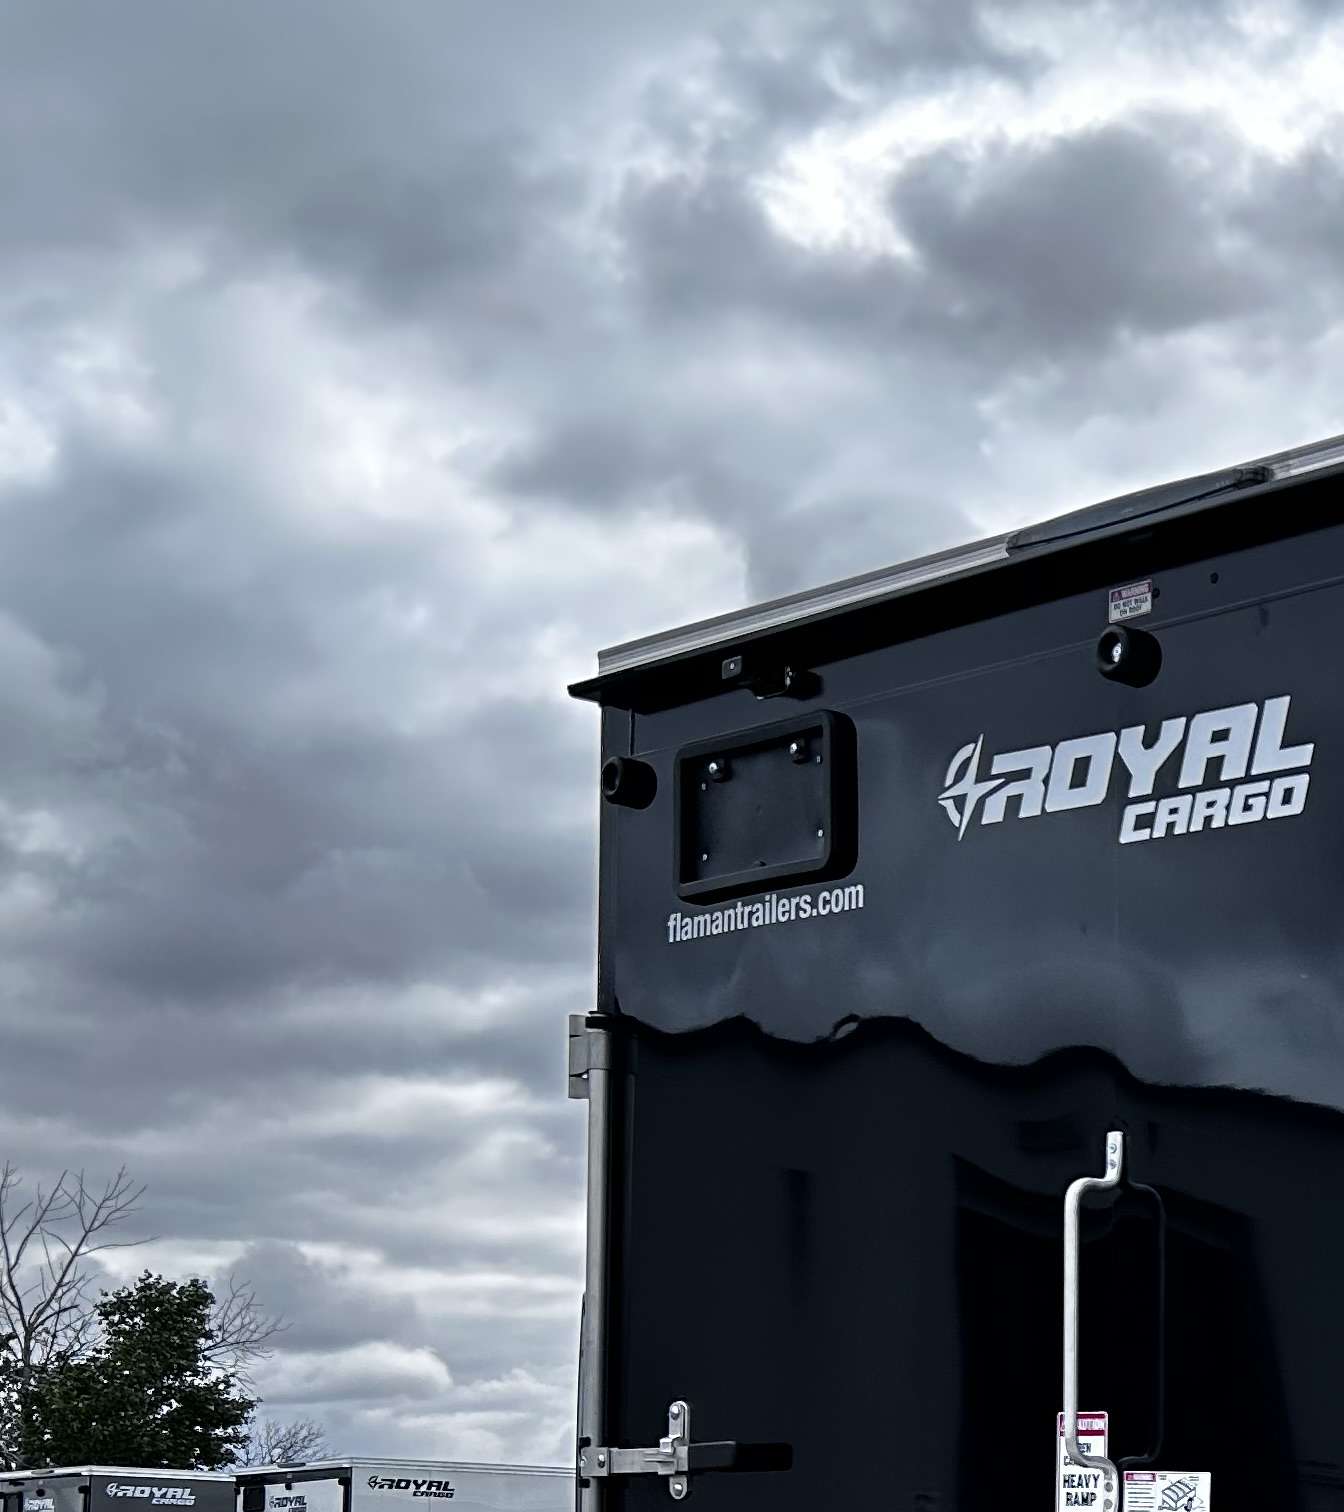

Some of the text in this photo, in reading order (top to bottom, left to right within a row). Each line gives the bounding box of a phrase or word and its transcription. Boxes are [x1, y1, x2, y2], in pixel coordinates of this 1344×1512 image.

[981, 695, 1315, 825] ROYAL
[1118, 773, 1311, 844] CARGO
[667, 883, 864, 943] flamantrailers.com
[378, 1478, 455, 1491] ROYAL
[1063, 1473, 1100, 1489] HEAVY
[117, 1485, 196, 1499] ROYAL
[1065, 1491, 1097, 1507] RAMP
